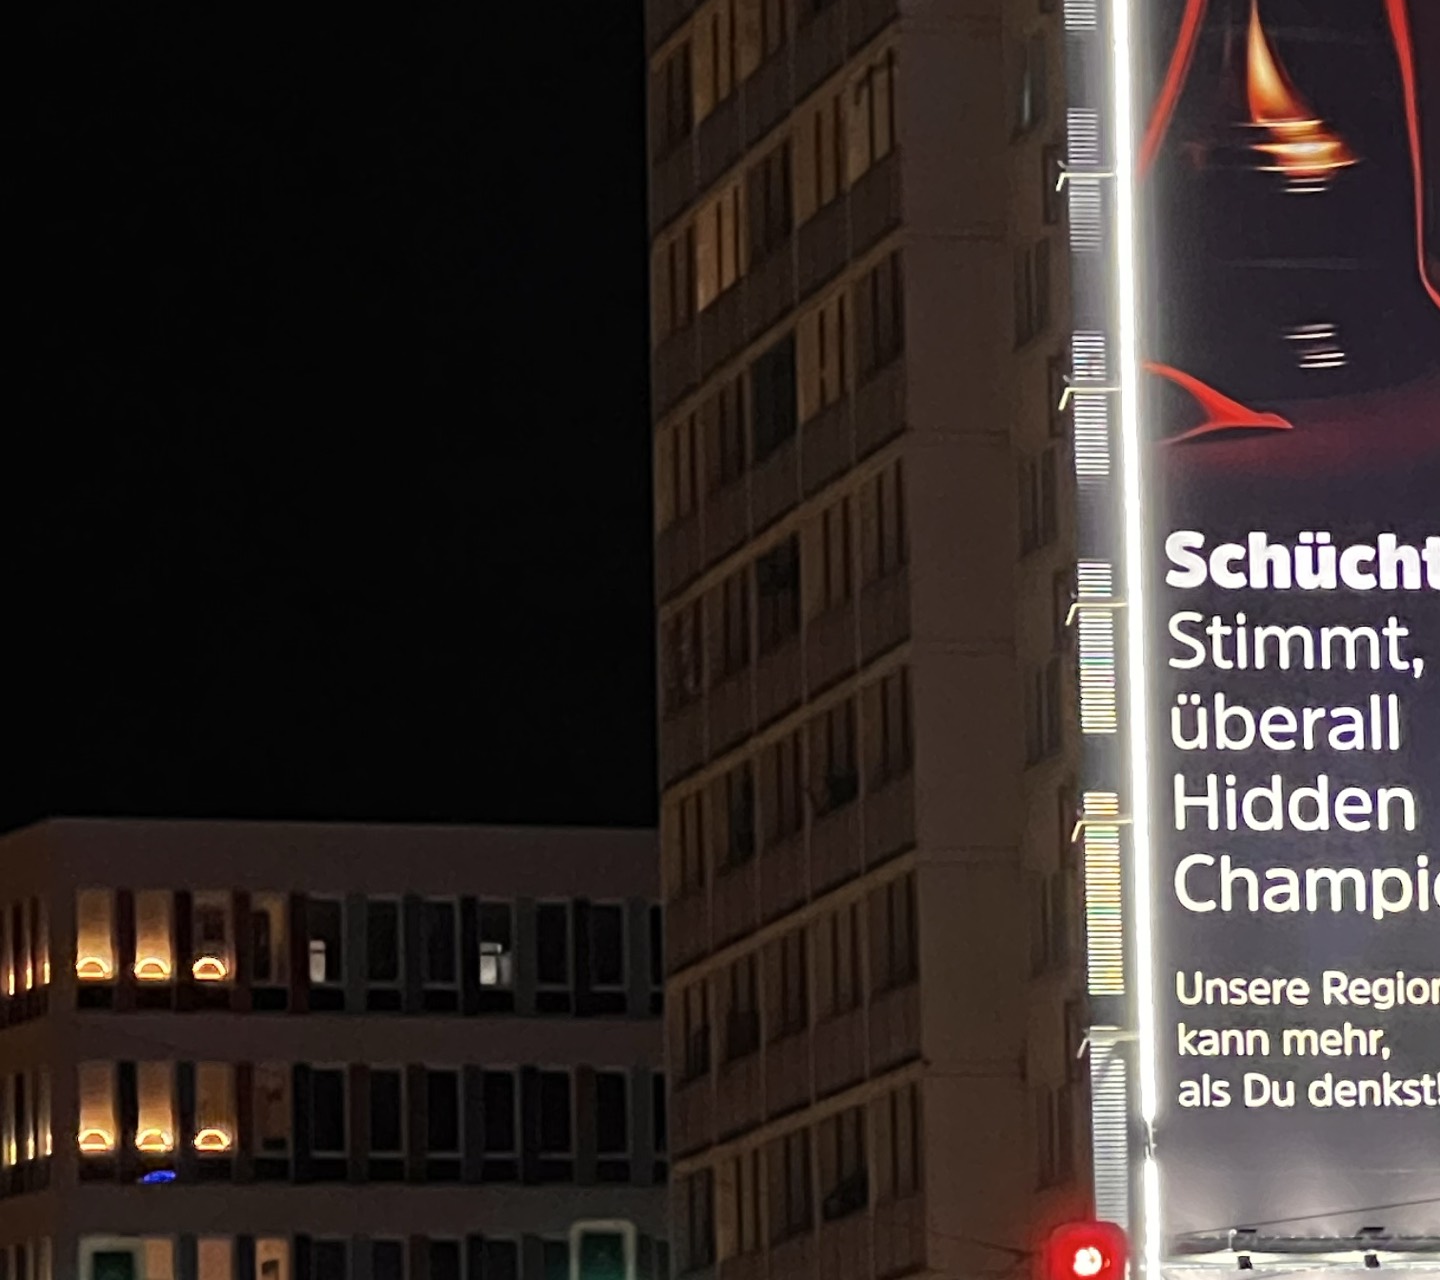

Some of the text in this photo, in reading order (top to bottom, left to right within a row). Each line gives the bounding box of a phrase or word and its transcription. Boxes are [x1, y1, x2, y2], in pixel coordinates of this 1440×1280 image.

[1167, 611, 1425, 679] Stimmt,
[1171, 692, 1400, 751] überall
[1174, 773, 1416, 832] Hidden
[1176, 971, 1310, 1006] Unsere
[1178, 1022, 1391, 1060] kann mehr,
[1178, 1073, 1231, 1108] als
[1243, 1072, 1295, 1108] Du
